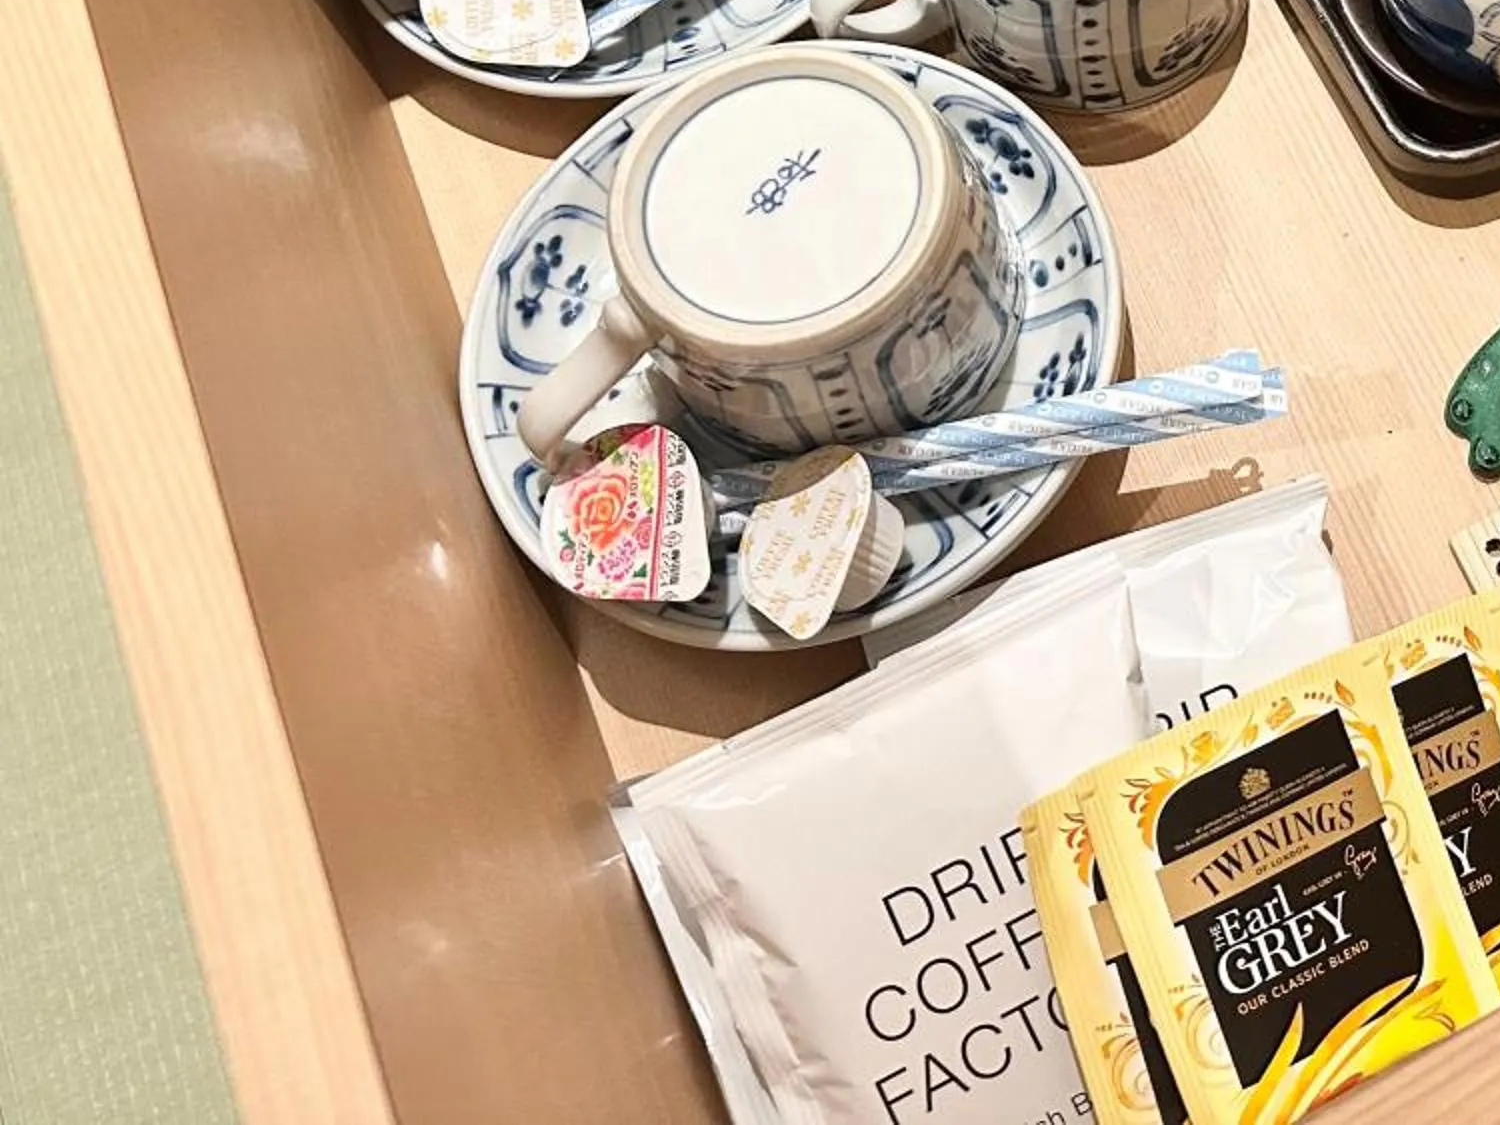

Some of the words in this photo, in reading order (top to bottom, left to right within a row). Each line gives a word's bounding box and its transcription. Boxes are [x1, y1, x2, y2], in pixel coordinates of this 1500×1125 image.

[1413, 740, 1481, 780] INGS
[1191, 798, 1355, 898] TWININGS
[1461, 873, 1493, 897] LEND
[1210, 922, 1227, 952] THE
[1216, 883, 1294, 947] Earl
[1217, 890, 1352, 994] GREY
[865, 907, 1043, 1042] COFF
[1237, 993, 1269, 1015] OUR
[1271, 962, 1325, 999] CLASSIC
[1328, 938, 1370, 969] BLEND
[875, 986, 1069, 1125] FACT
